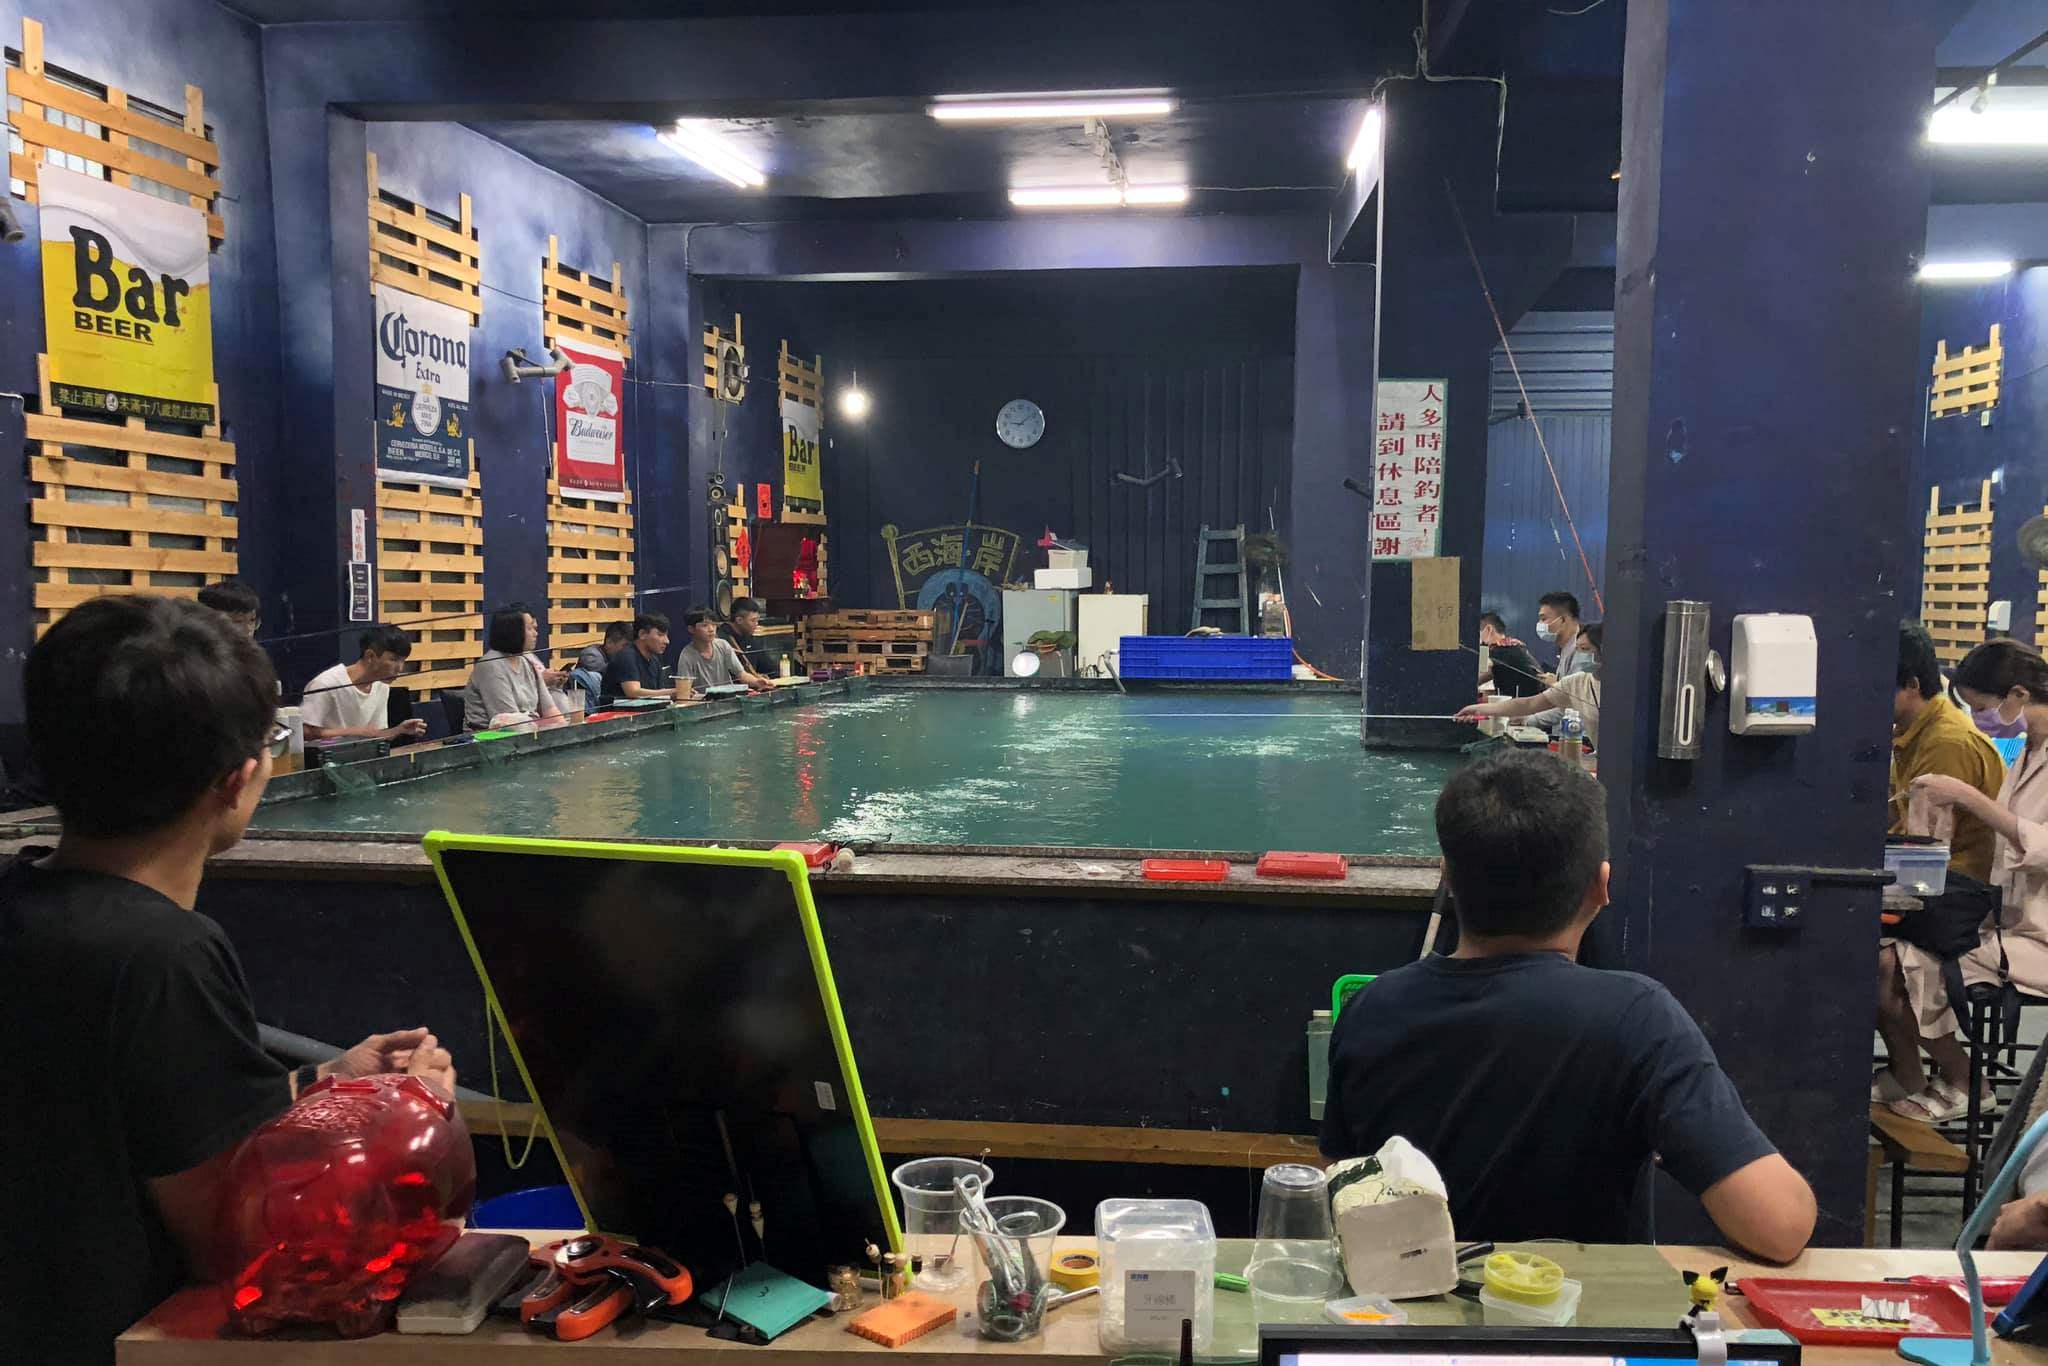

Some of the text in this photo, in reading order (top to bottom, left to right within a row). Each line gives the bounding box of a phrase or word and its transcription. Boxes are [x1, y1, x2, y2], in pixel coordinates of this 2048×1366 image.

[69, 225, 189, 327] Bar
[74, 311, 153, 342] BEER
[380, 312, 467, 370] Corona
[415, 362, 441, 384] Extra
[569, 417, 613, 441] Budweiser
[788, 424, 815, 466] Bar
[902, 531, 1006, 577] 西海岸
